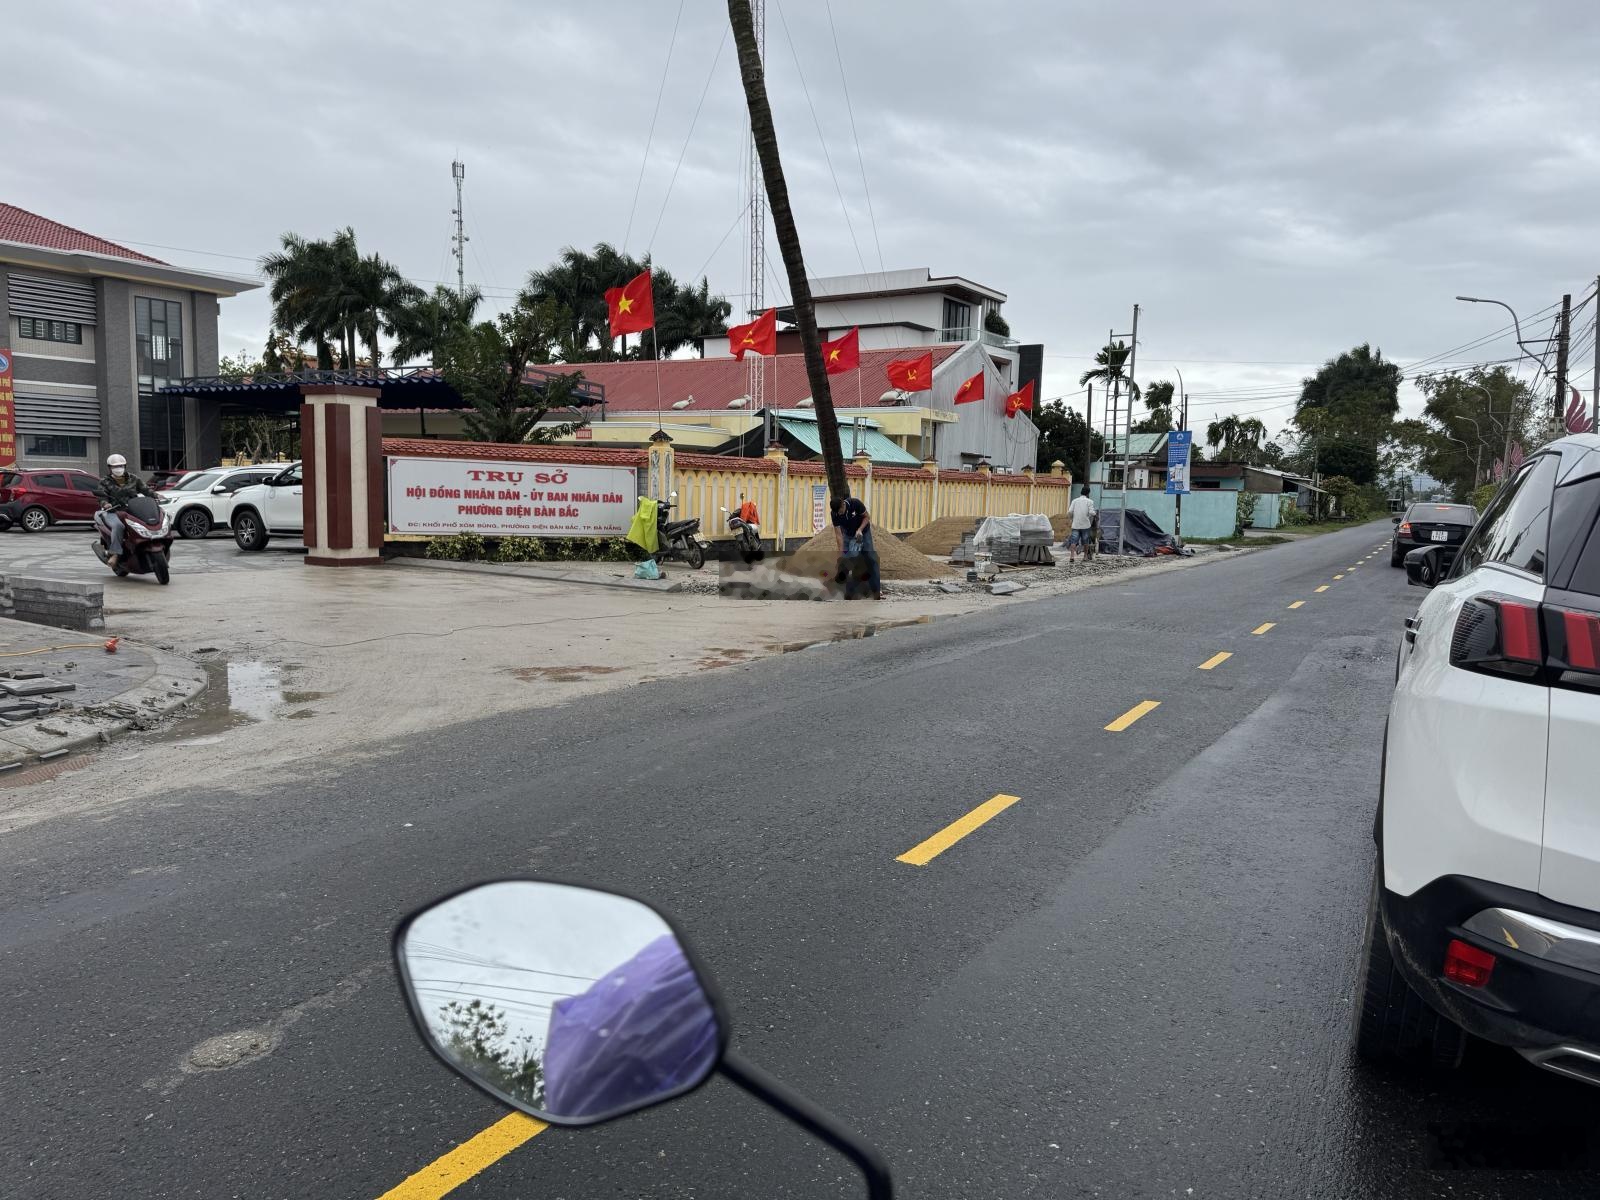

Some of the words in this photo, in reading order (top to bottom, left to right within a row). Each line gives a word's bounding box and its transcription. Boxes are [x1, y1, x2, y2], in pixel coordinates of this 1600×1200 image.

[467, 471, 524, 485] TRỤ
[535, 469, 568, 484] SỞ
[406, 485, 426, 500] HỘI
[464, 488, 495, 500] NHÂN
[498, 489, 520, 500] DÂN
[547, 491, 569, 502] BAN
[602, 492, 623, 504] DÂN
[458, 503, 503, 516] PHƯỜNG
[505, 504, 531, 518] ĐIỆN
[534, 505, 556, 517] BÀN
[558, 504, 579, 518] BẮC
